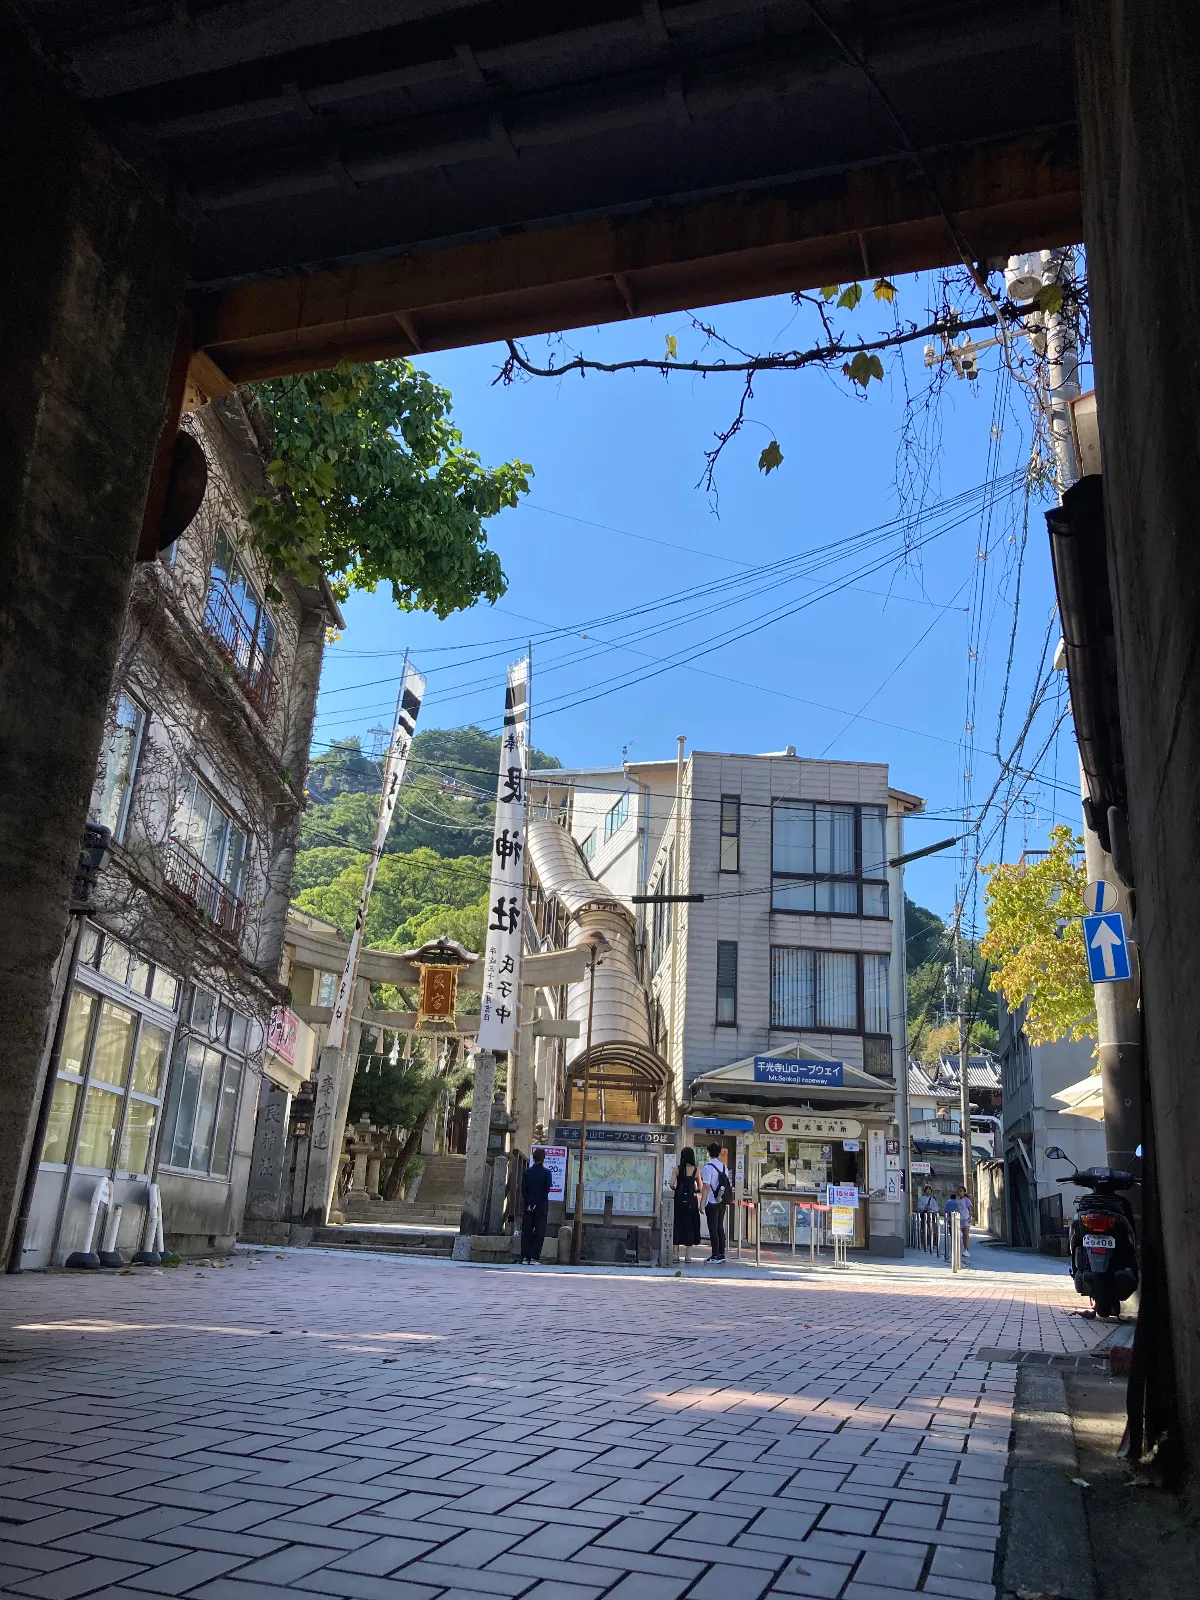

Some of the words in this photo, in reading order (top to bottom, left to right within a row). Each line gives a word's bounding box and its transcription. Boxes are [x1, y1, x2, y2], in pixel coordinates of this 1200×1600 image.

[791, 1122, 848, 1133] 観光案内所
[562, 1128, 668, 1143] 千光山ロープウェイのりば
[888, 1177, 896, 1193] 入口
